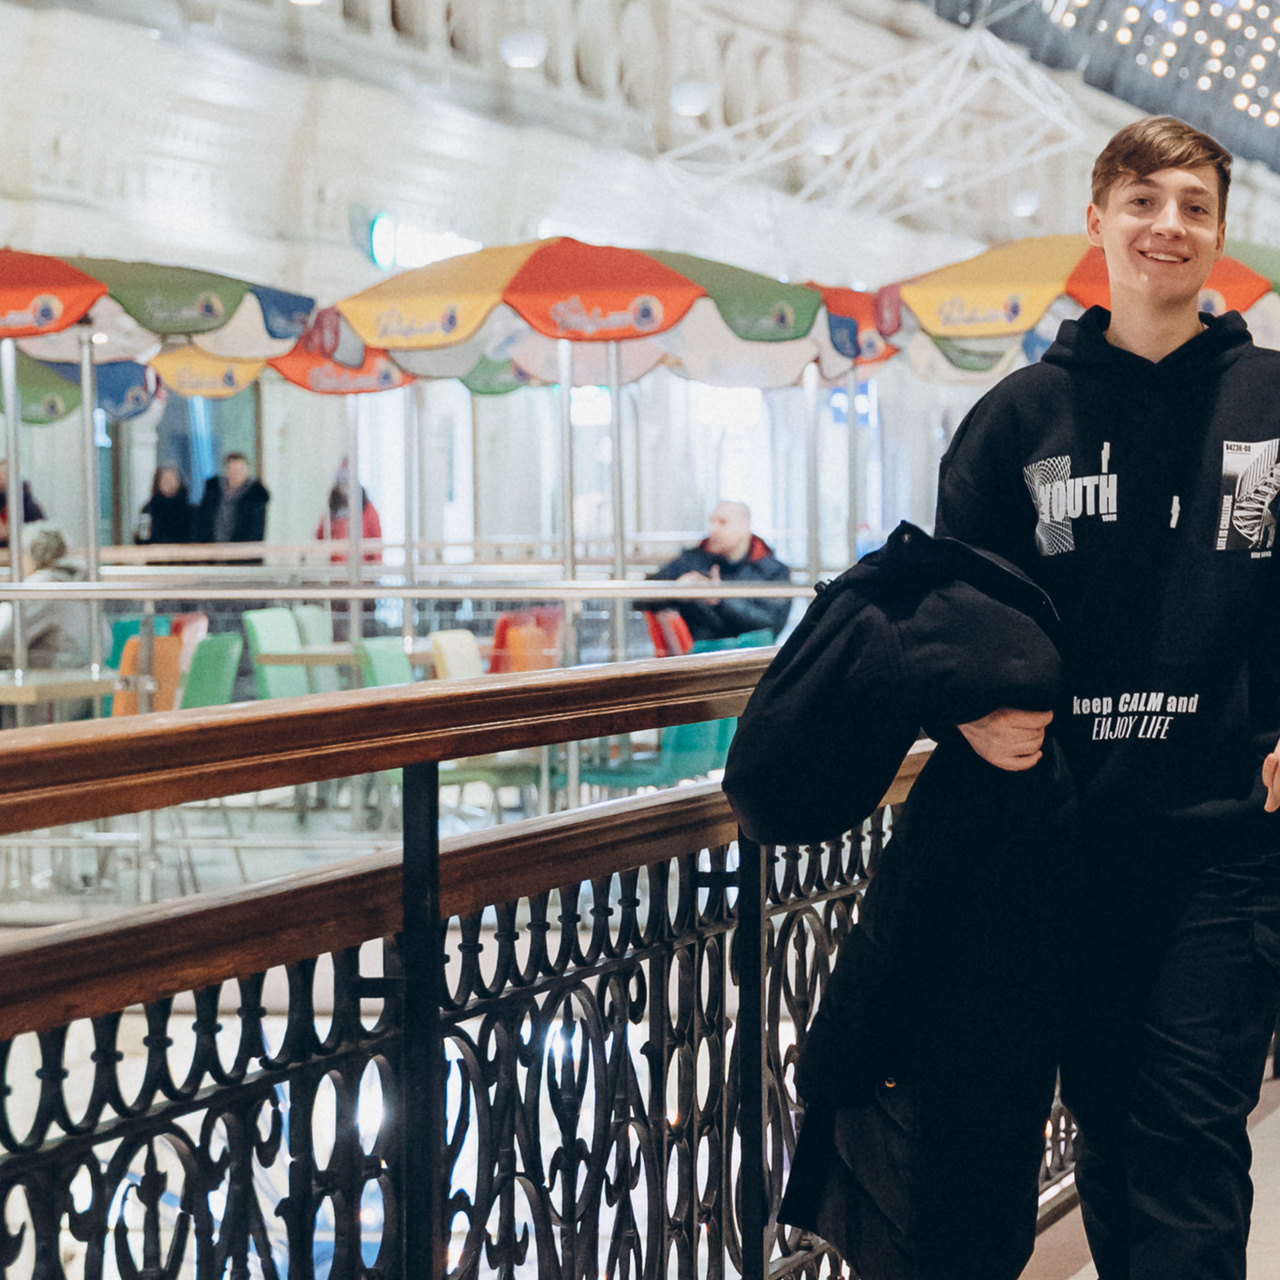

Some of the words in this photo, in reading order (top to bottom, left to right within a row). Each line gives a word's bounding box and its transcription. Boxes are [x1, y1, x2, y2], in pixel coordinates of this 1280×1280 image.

[1038, 474, 1117, 523] YOUTH
[1073, 696, 1112, 715] keep
[1118, 692, 1164, 713] CALM
[1166, 694, 1199, 713] and
[1138, 715, 1174, 739] LIFE
